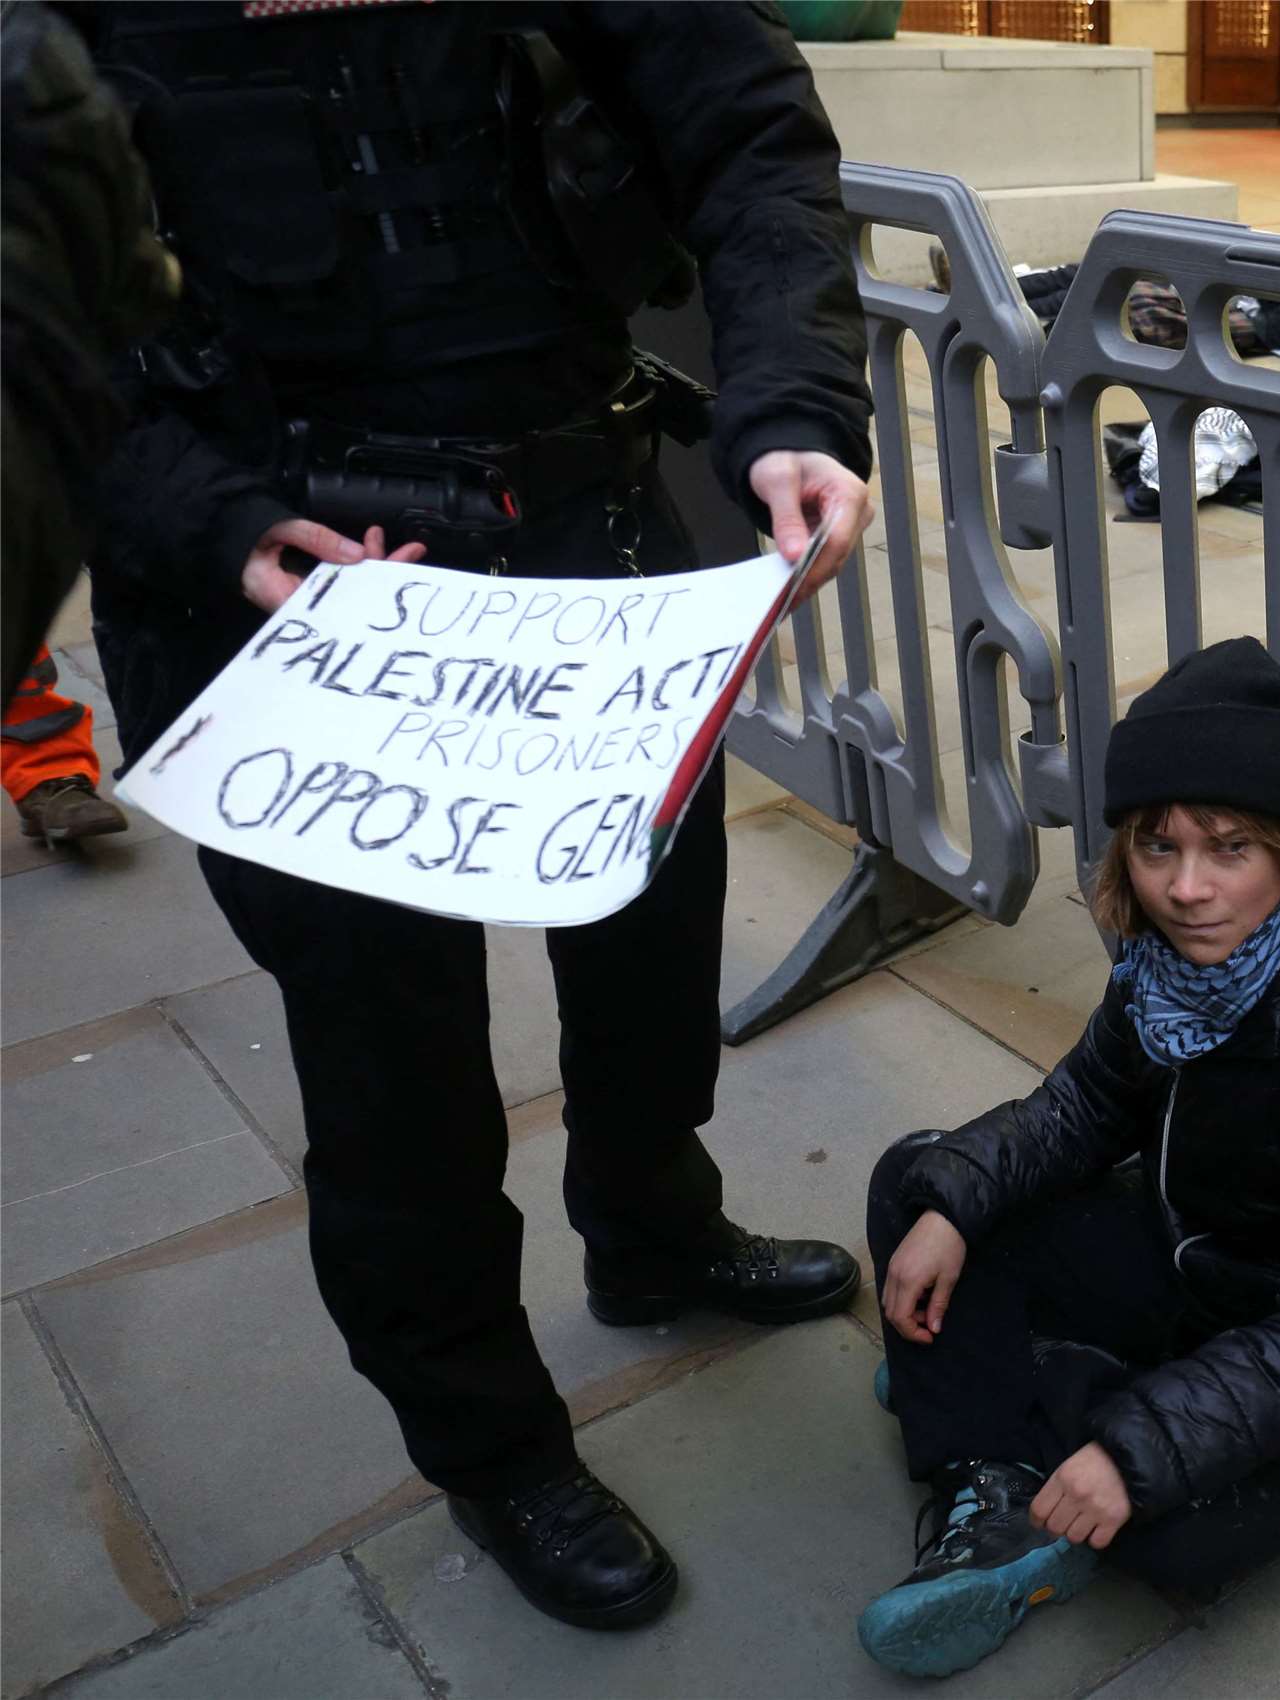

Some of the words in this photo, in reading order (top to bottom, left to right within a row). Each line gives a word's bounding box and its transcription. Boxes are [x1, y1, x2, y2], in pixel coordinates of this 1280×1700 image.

[368, 581, 691, 645] SUPPORT
[251, 619, 588, 720] PALESTINE
[377, 712, 693, 775] PRISONERS
[217, 747, 523, 875] OPPOSE
